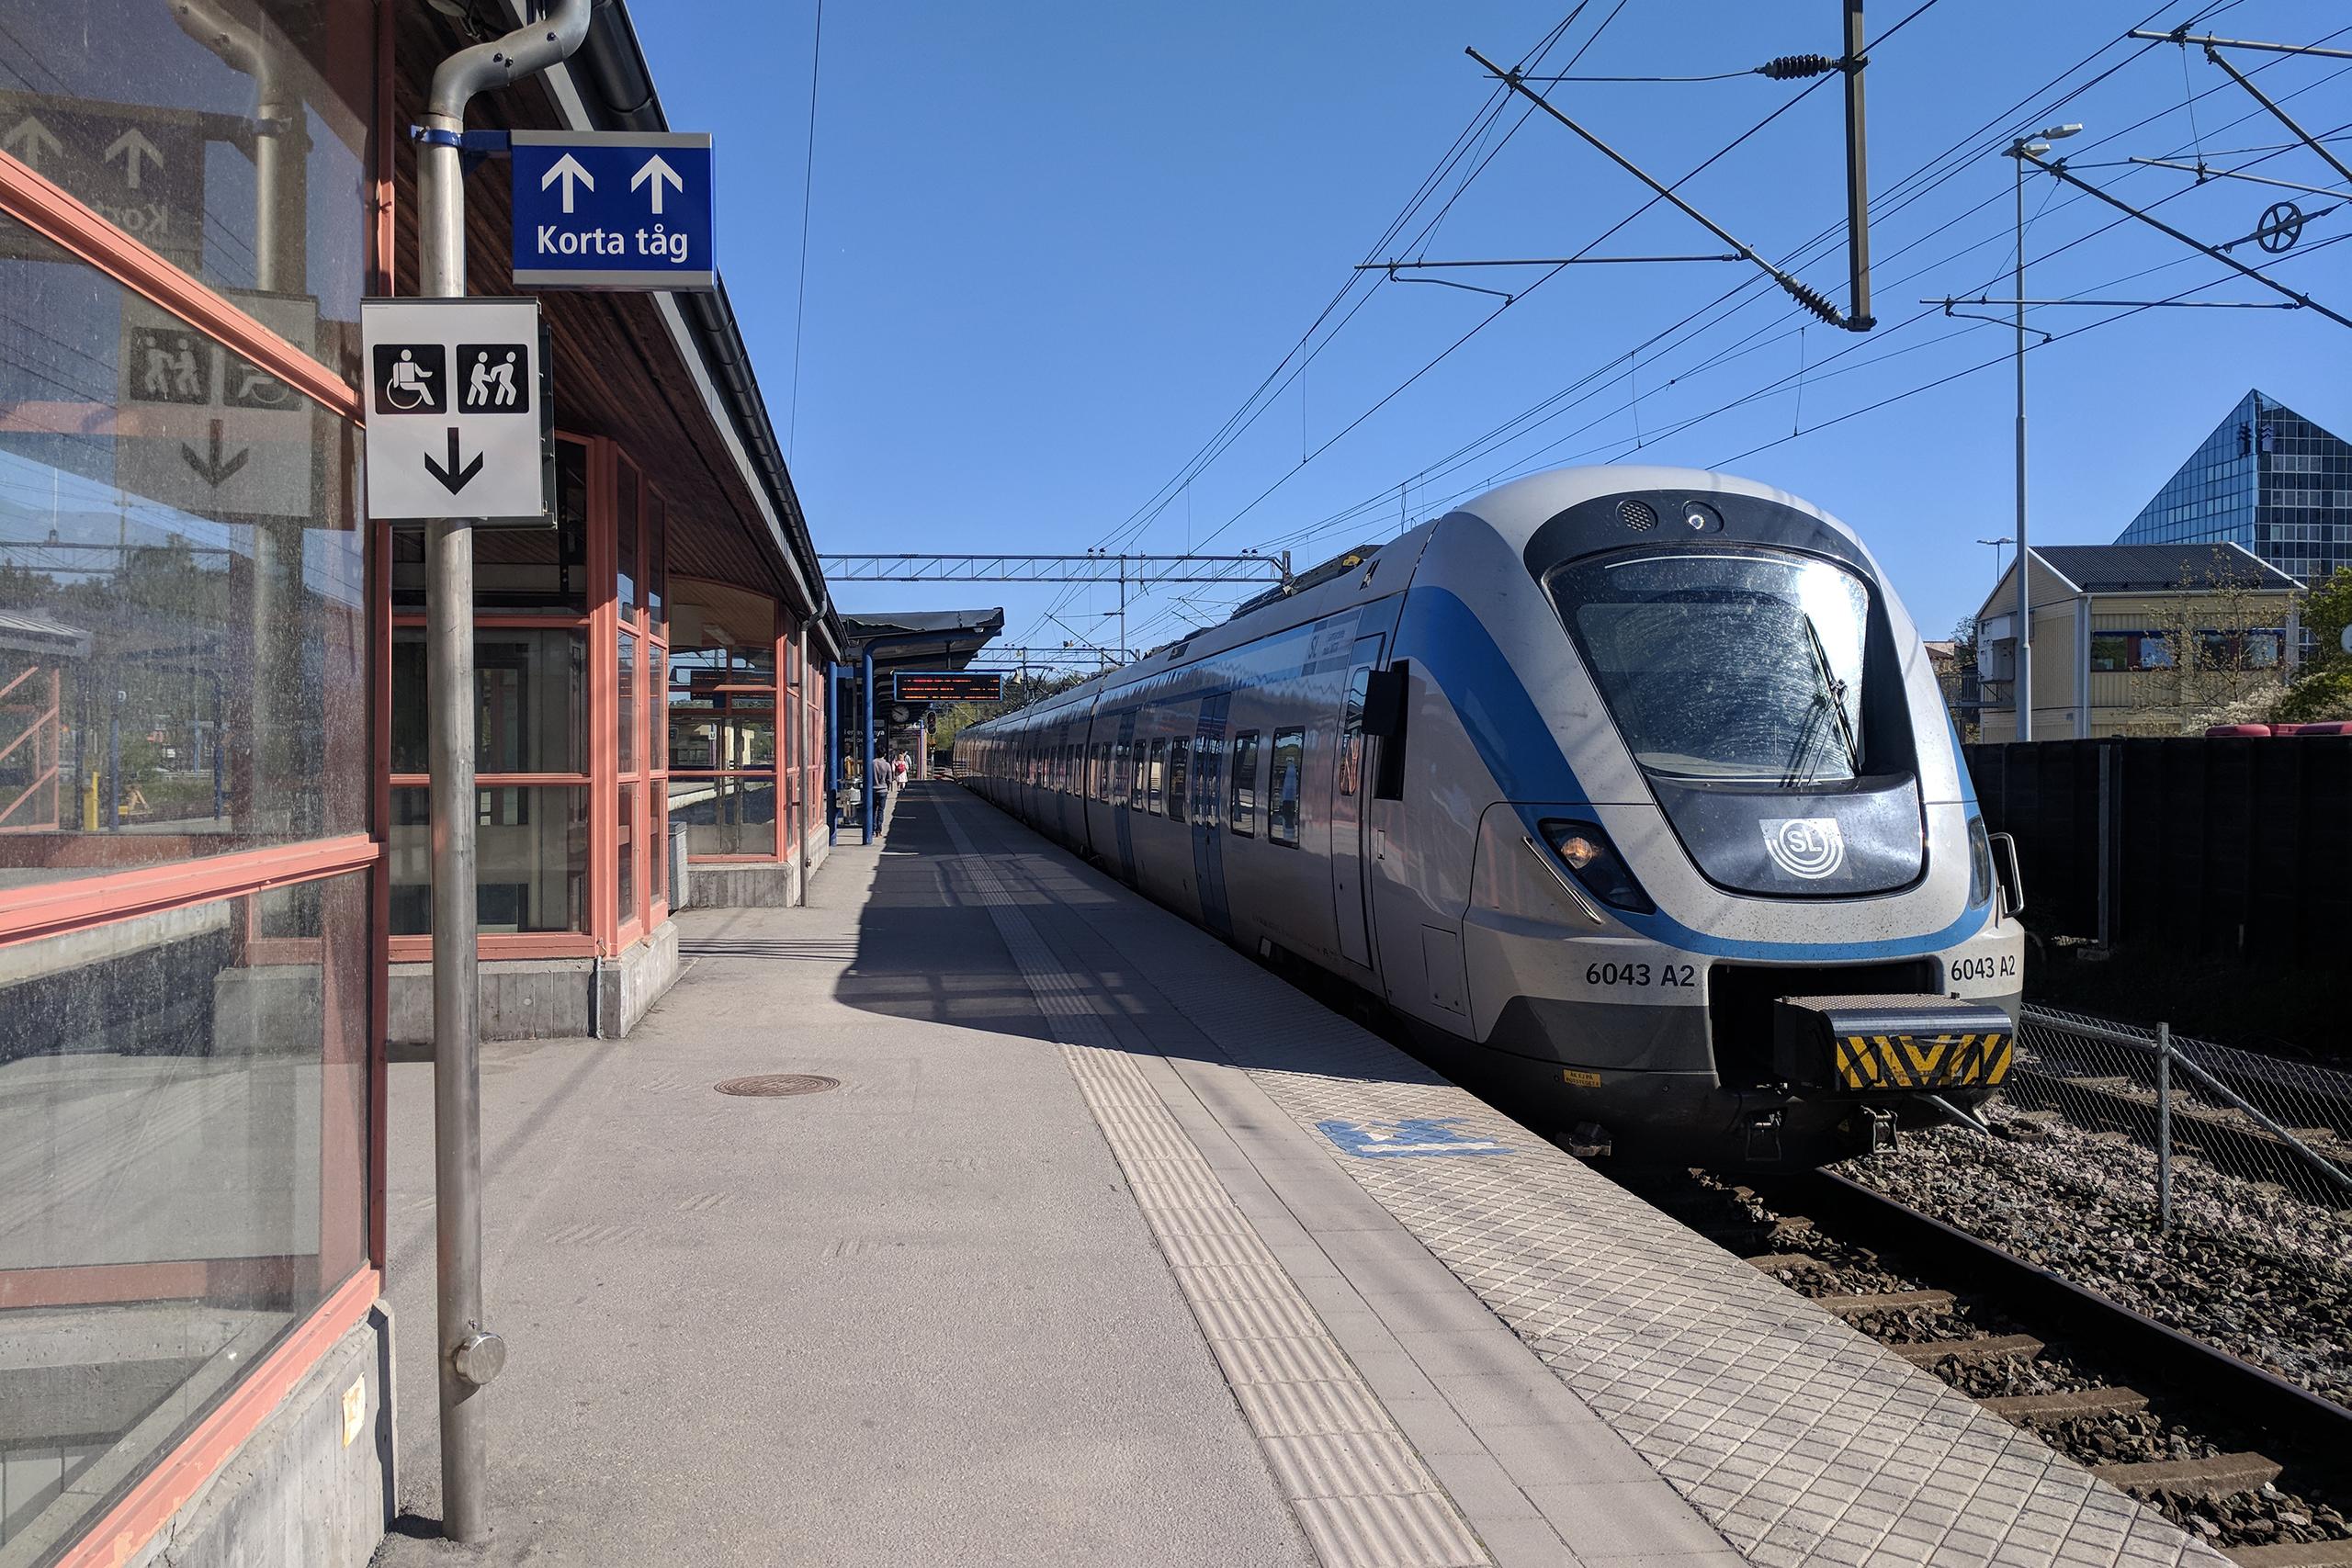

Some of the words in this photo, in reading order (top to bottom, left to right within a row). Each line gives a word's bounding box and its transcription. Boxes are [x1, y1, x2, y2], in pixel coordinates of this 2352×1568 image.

[537, 225, 625, 255] Korta
[635, 223, 688, 264] tåg
[1586, 963, 1651, 986] 6043
[1660, 964, 1695, 987] A2
[1951, 957, 1995, 981] 6043
[2000, 955, 2015, 976] A2
